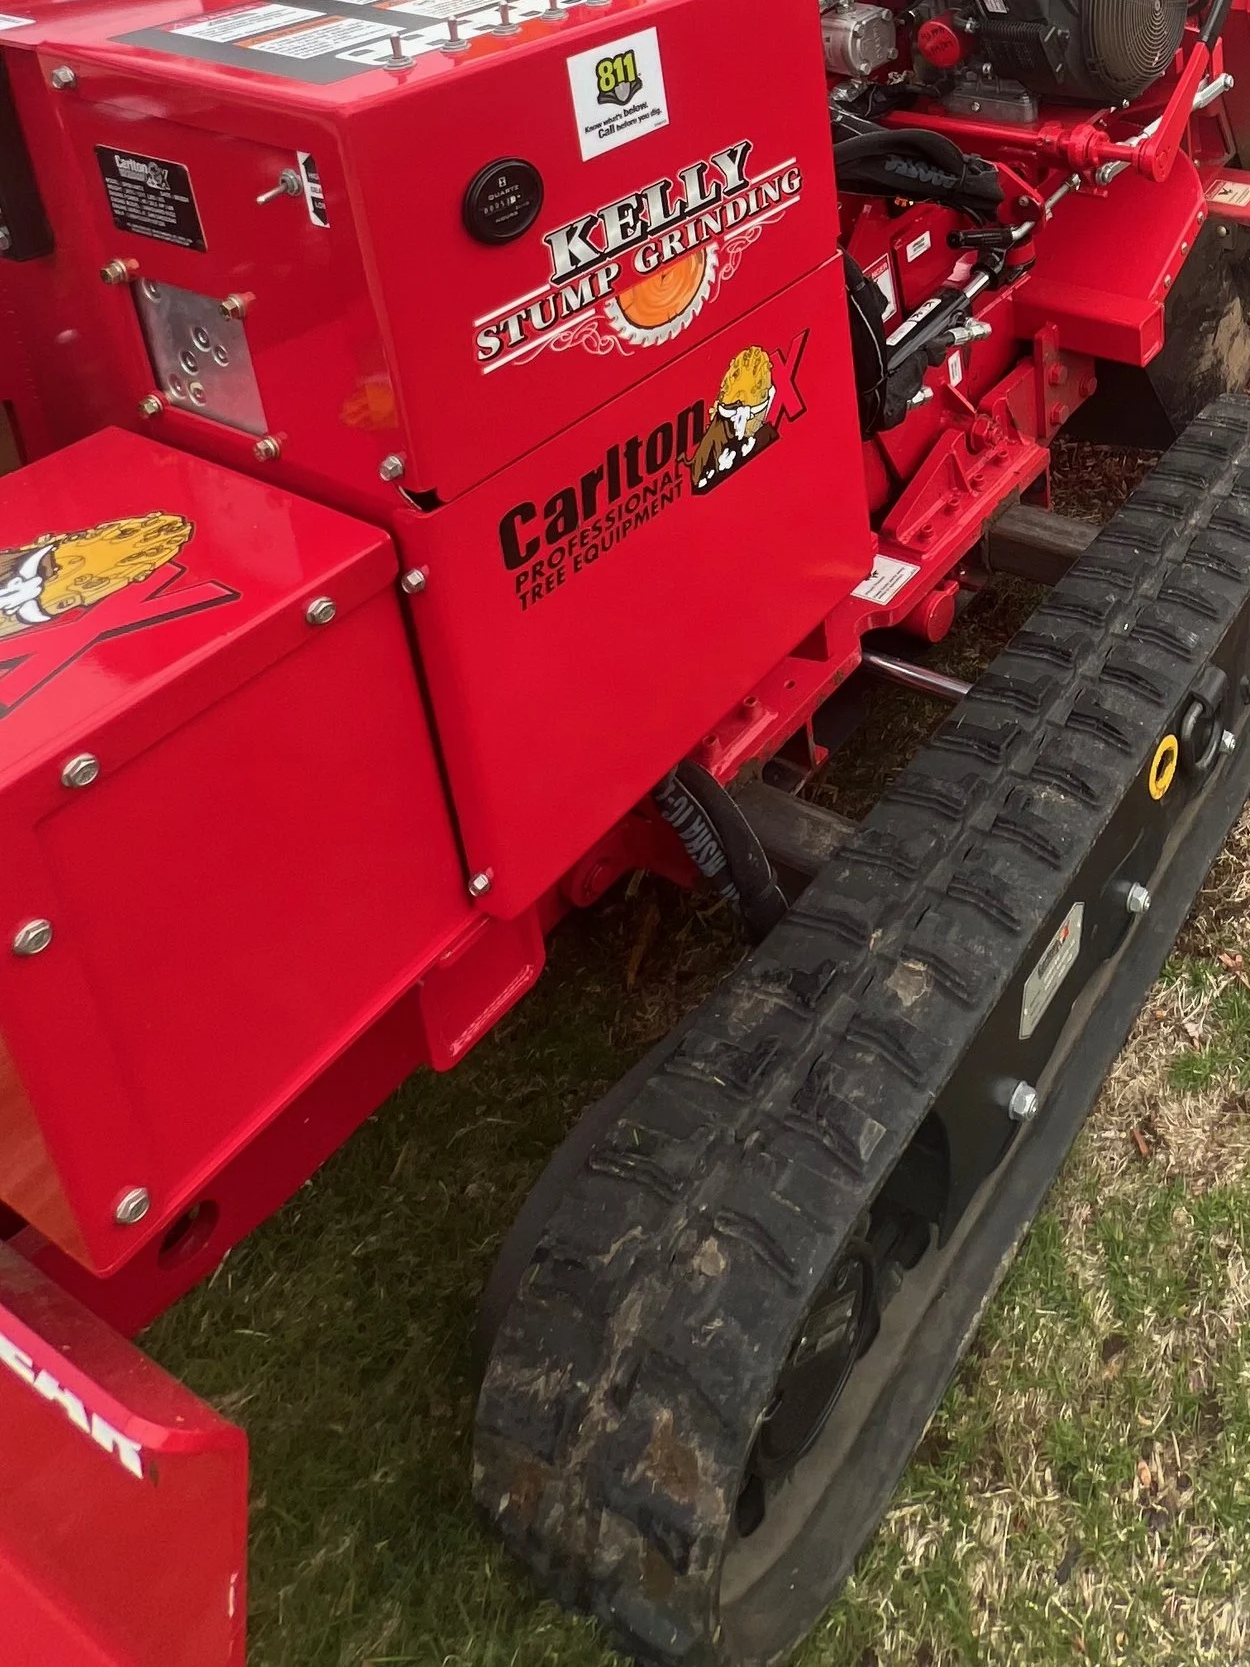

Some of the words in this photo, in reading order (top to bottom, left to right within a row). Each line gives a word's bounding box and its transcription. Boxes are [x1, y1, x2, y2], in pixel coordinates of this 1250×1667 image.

[584, 122, 603, 134] Know
[603, 113, 622, 126] what's
[596, 49, 638, 92] 811
[598, 125, 615, 139] Call
[616, 118, 638, 132] before
[638, 113, 650, 123] you
[487, 184, 520, 201] QUARTZ
[544, 139, 753, 285] KELLY
[475, 260, 621, 362] STUMP
[633, 166, 802, 276] GRINDING
[498, 399, 705, 571] Carlton
[514, 468, 684, 594] PROFESSIONAL
[517, 568, 567, 611] TREE
[572, 484, 684, 574] EQUIPMENT
